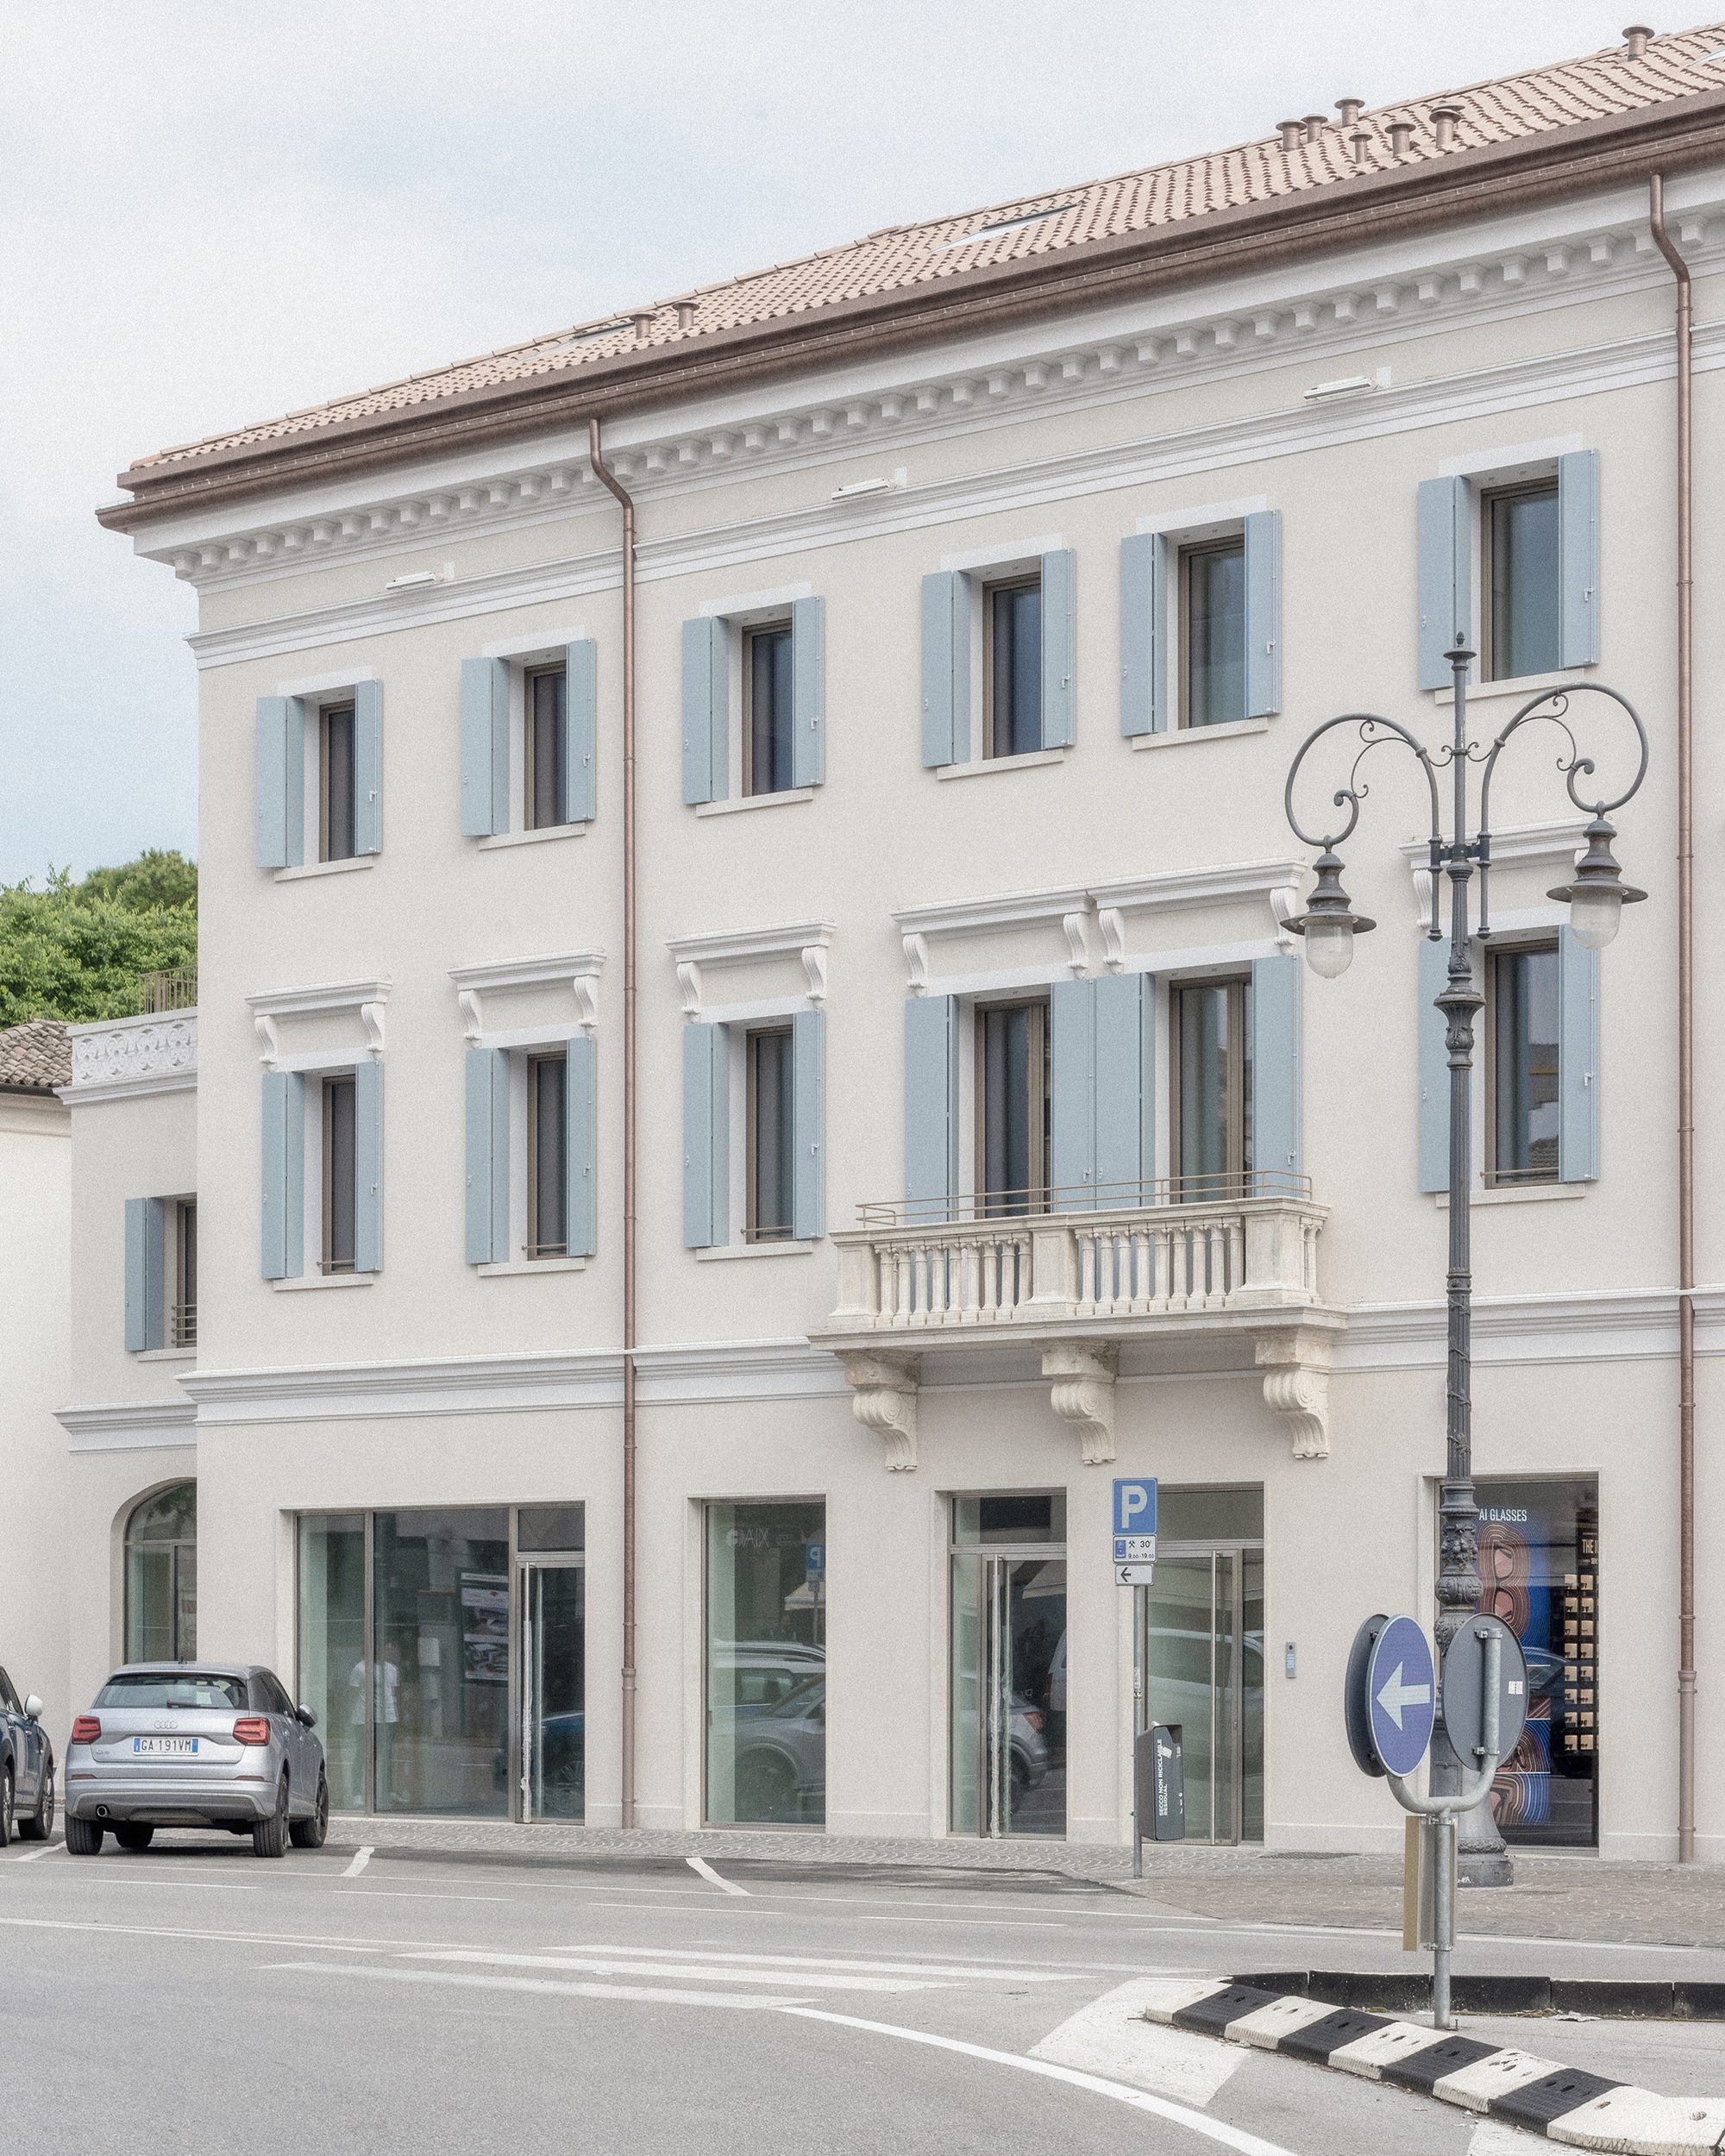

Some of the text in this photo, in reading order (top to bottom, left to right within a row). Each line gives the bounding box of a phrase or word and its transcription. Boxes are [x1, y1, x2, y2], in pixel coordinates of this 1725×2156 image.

[1121, 1485, 1148, 1529] P
[1478, 1508, 1527, 1522] AI GLASSES
[1582, 1539, 1594, 1553] THE
[141, 1739, 154, 1751] GA
[159, 1739, 191, 1752] 191VM
